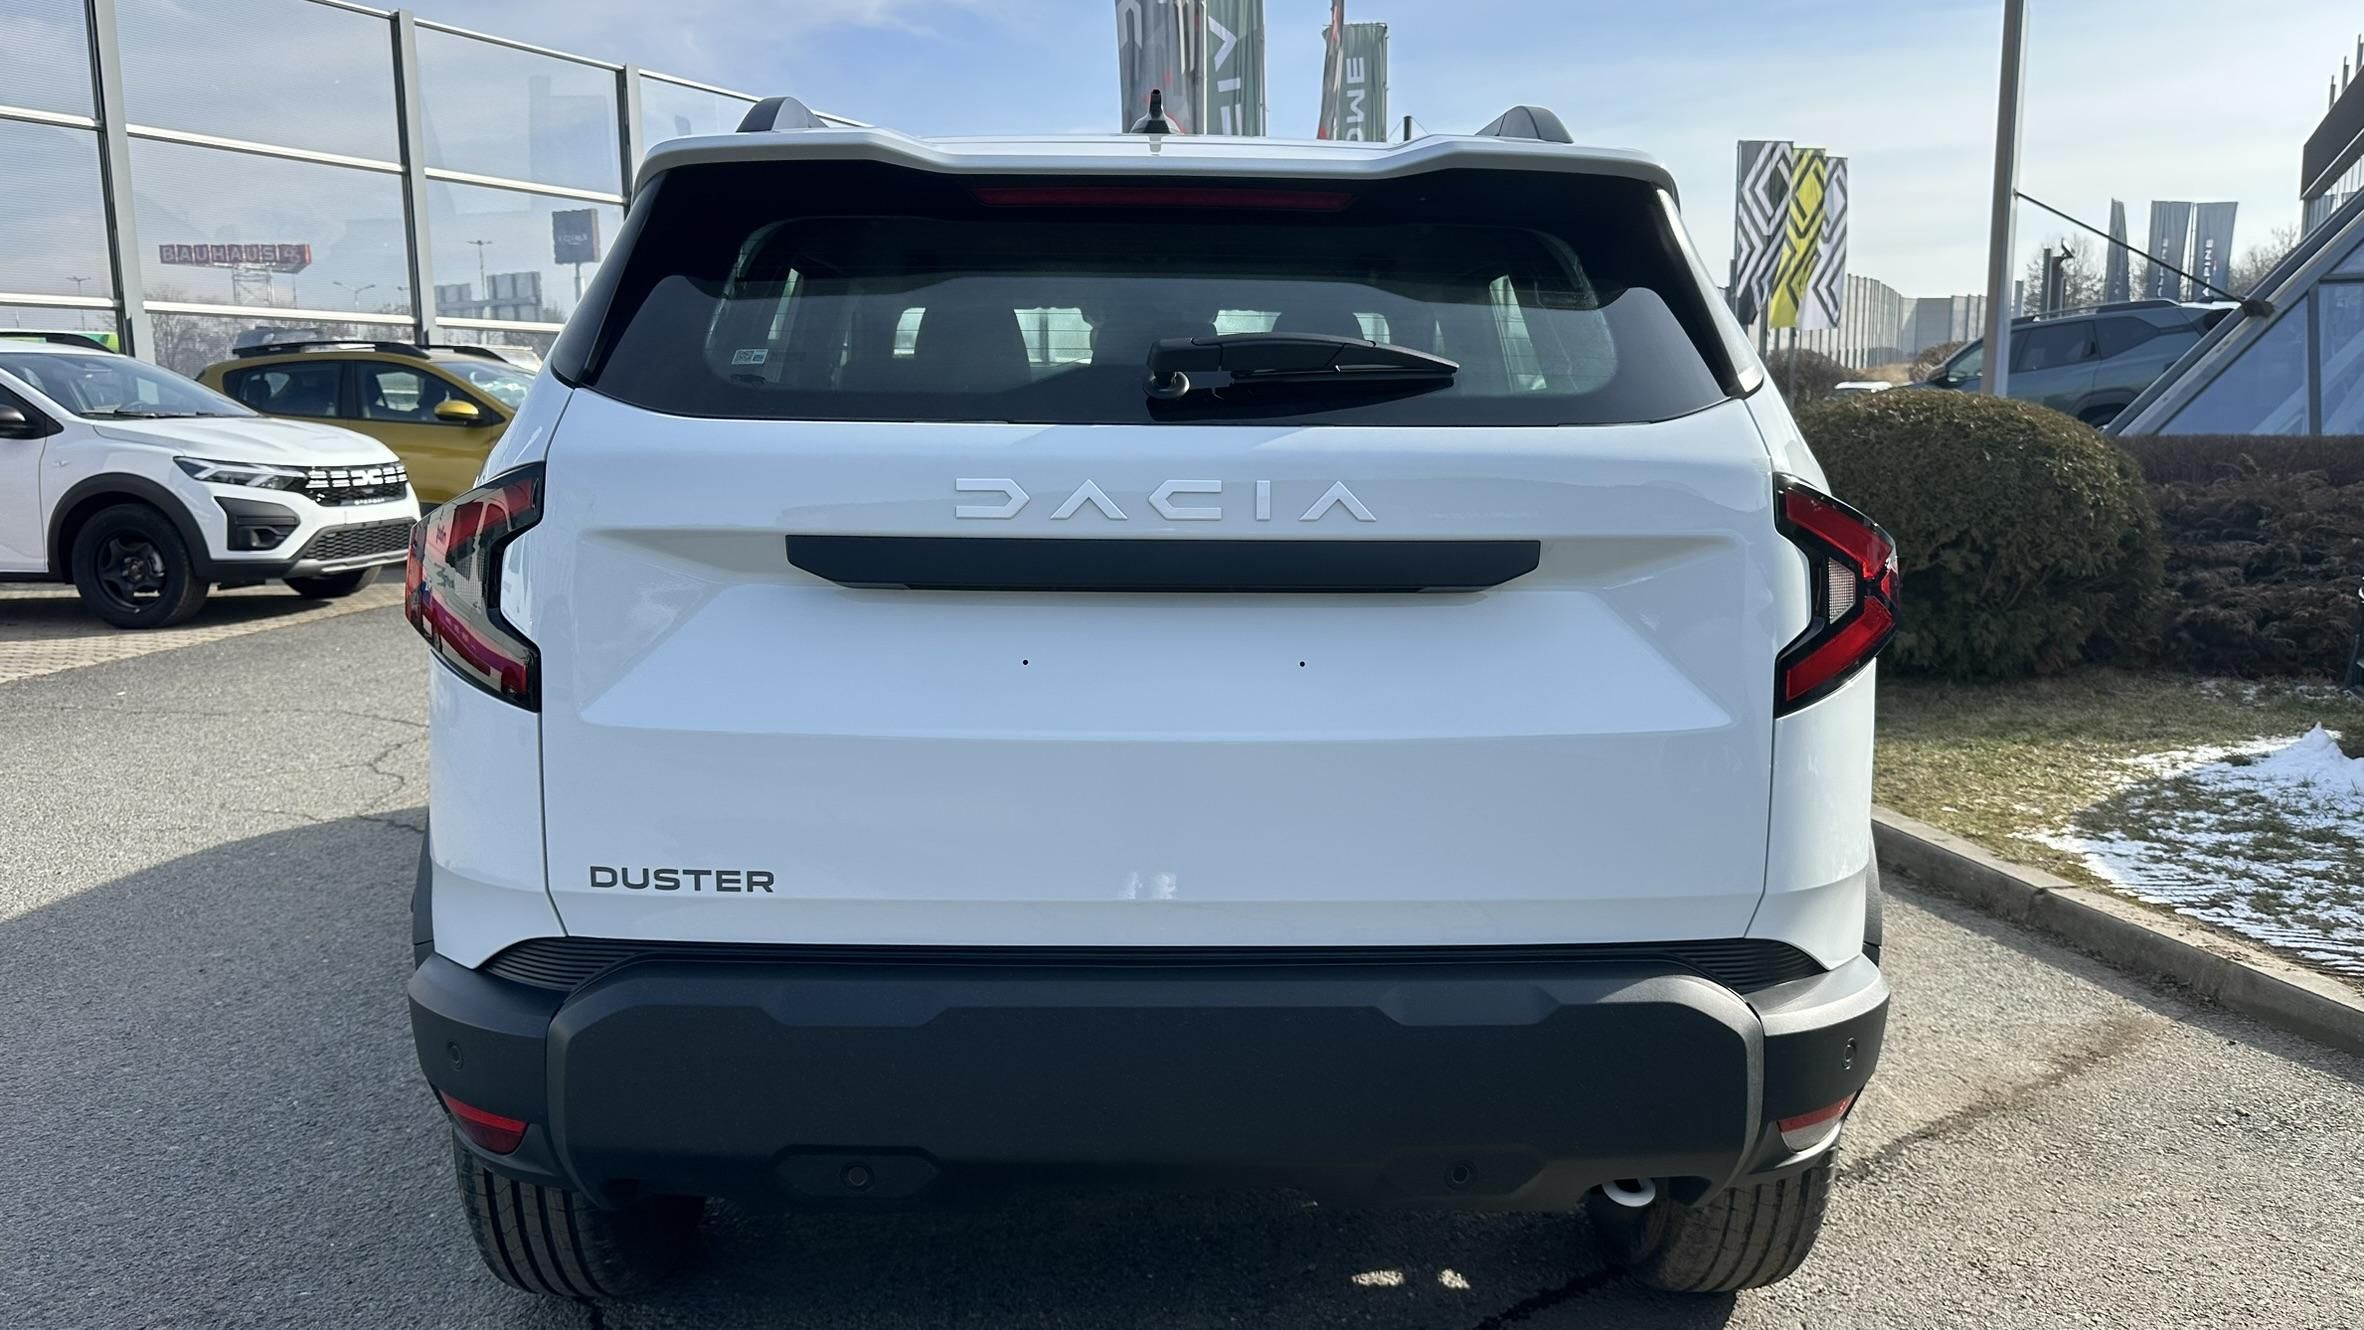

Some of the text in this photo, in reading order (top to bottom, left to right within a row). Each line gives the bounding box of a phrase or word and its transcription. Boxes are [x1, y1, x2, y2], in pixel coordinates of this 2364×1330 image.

[163, 247, 274, 262] BAUHAUS
[956, 478, 1376, 521] DACIA
[590, 866, 775, 893] DUSTER
